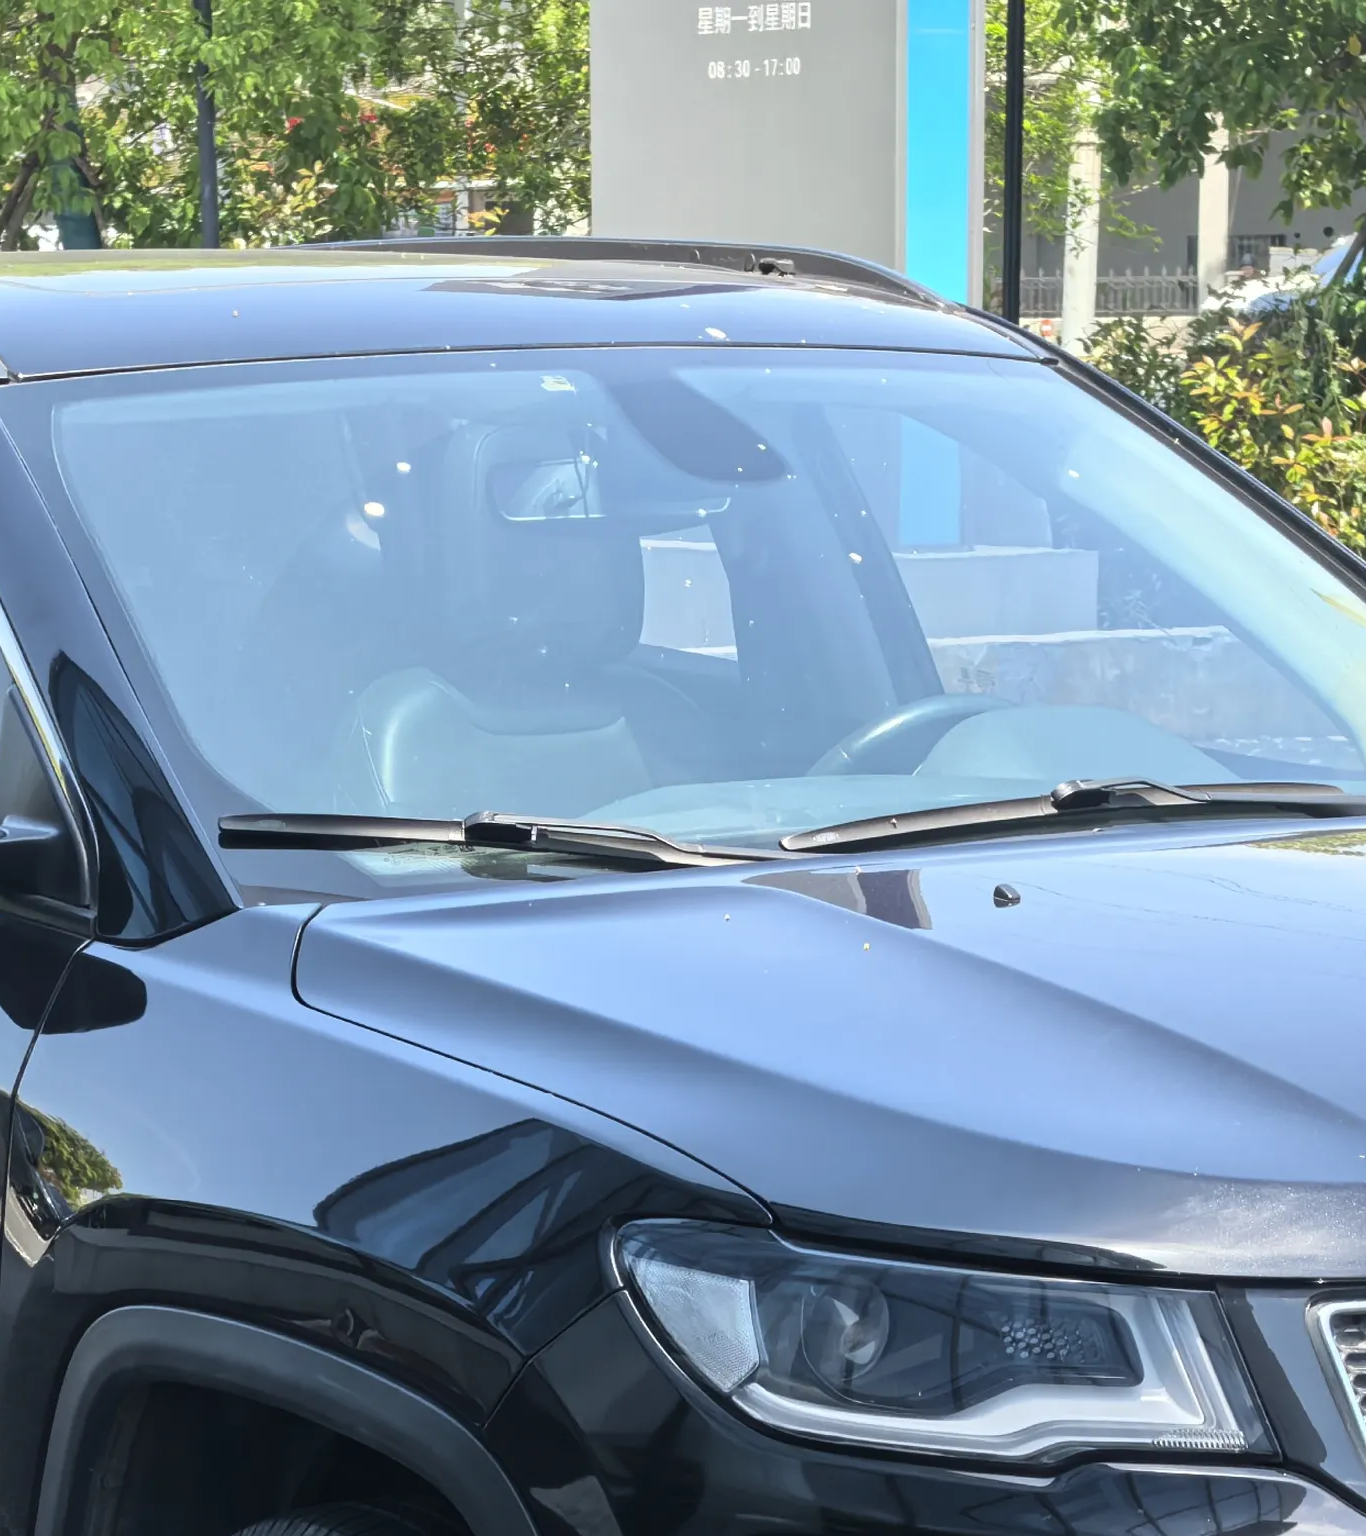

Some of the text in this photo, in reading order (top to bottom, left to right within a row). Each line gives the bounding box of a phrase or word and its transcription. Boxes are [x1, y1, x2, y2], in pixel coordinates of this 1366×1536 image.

[697, 2, 811, 34] 星期一到星期日
